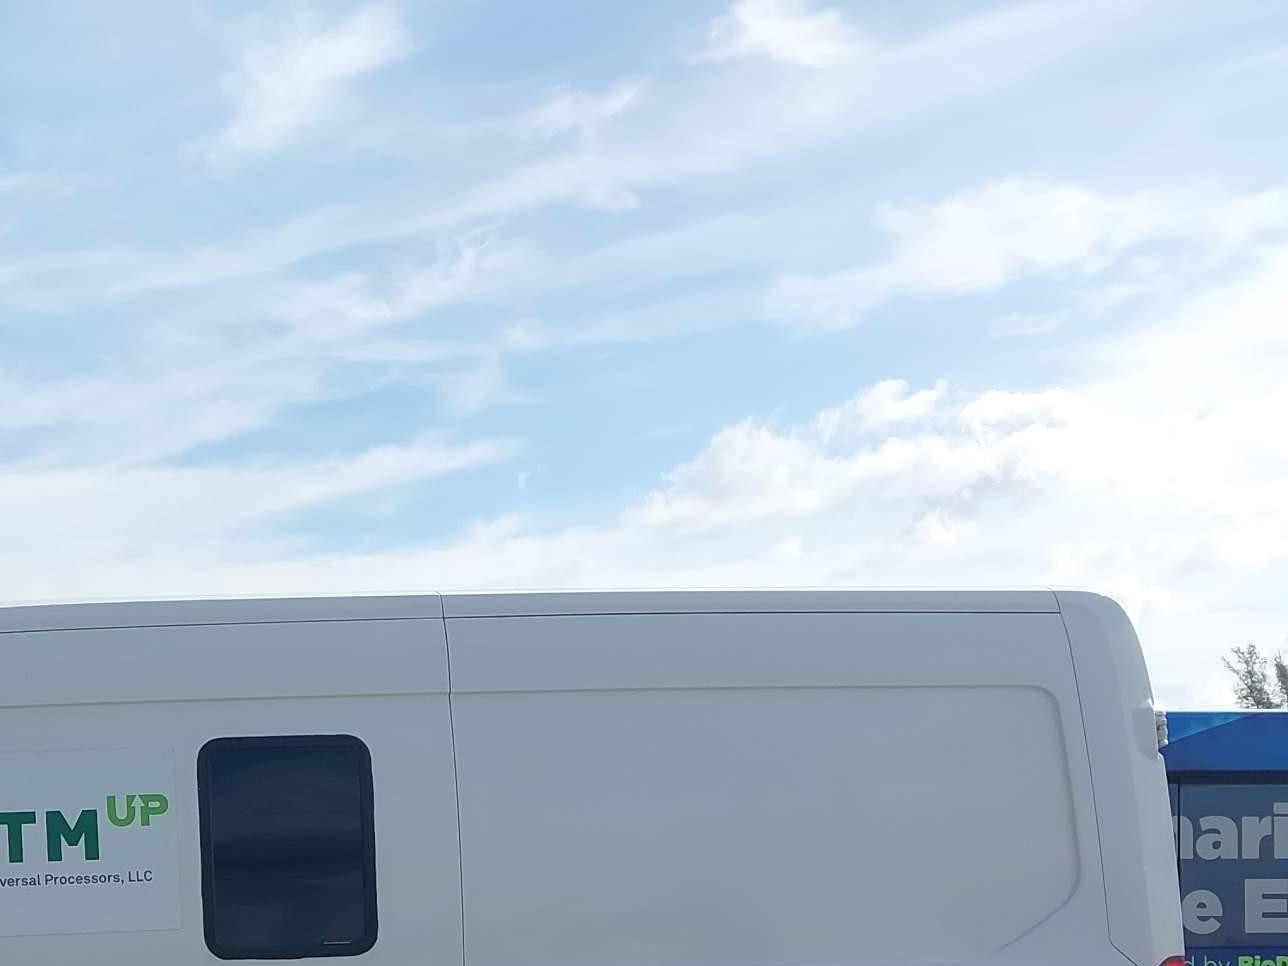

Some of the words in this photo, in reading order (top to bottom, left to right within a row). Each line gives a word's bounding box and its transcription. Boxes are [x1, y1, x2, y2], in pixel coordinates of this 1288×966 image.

[106, 794, 169, 827] UP
[44, 871, 125, 885] Processors,
[127, 870, 153, 882] LLC
